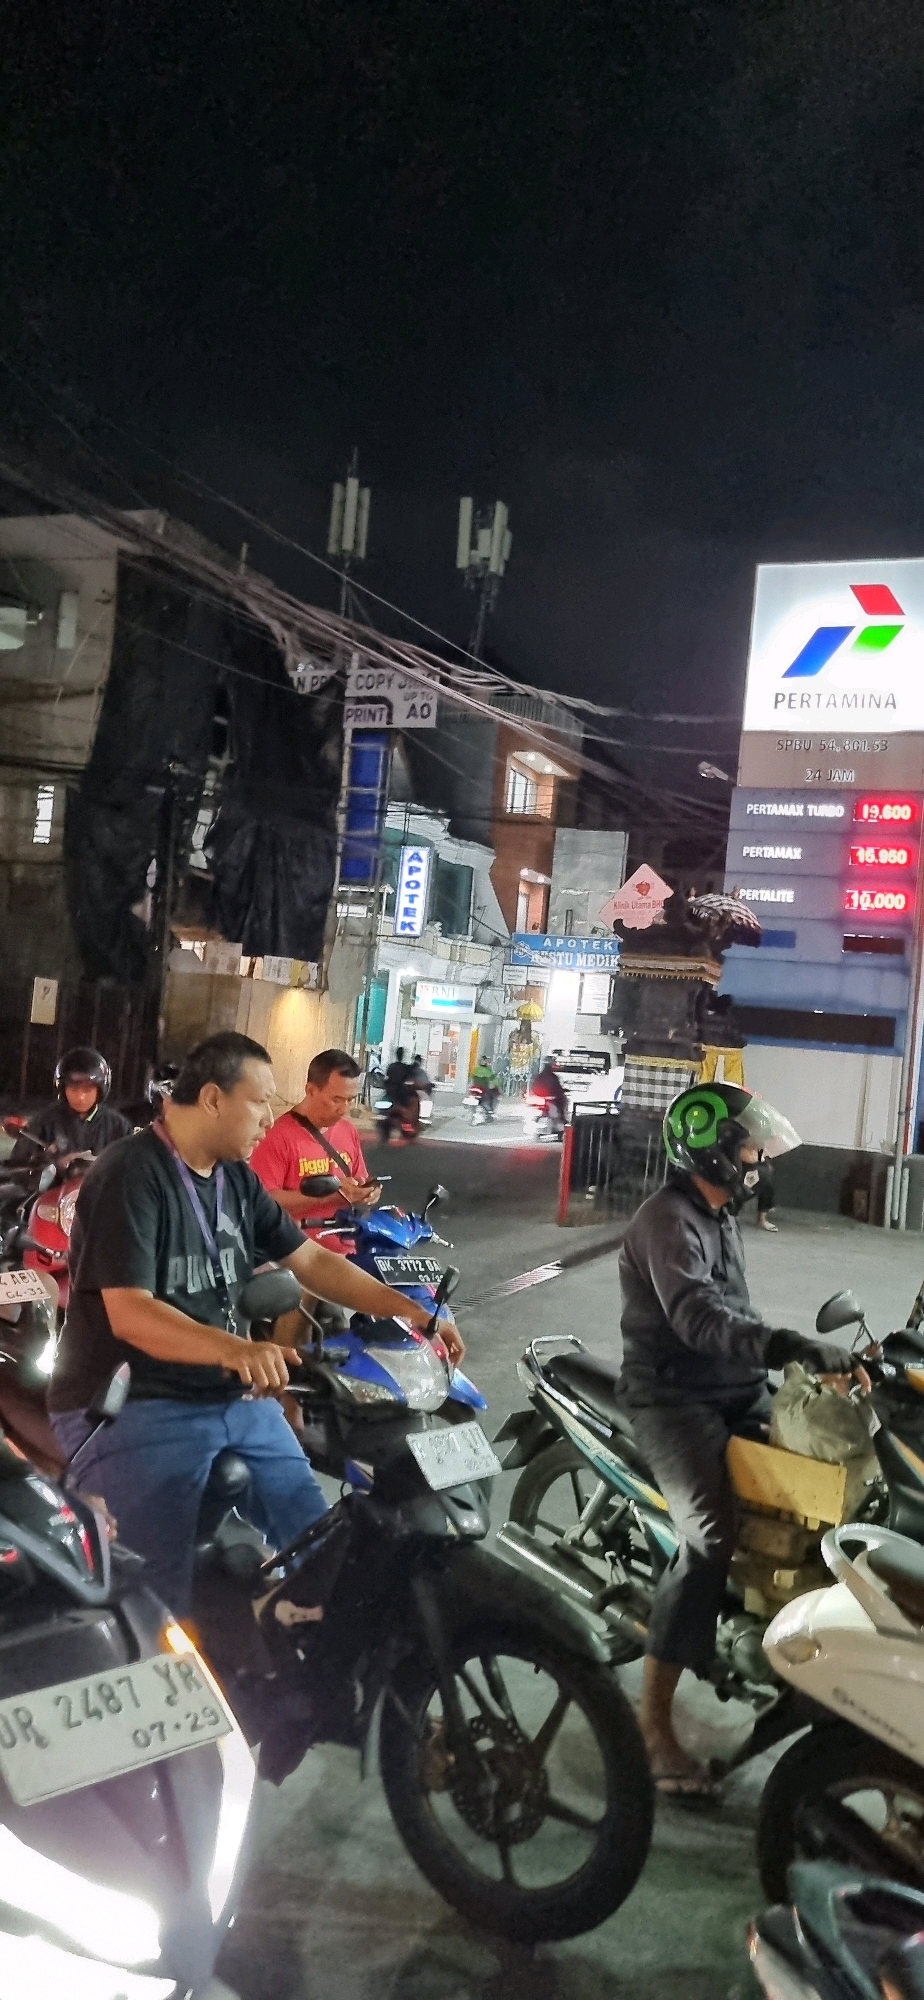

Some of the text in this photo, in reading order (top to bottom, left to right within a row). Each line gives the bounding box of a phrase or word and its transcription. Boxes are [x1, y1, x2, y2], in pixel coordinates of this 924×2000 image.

[355, 673, 396, 690] COPY
[773, 692, 897, 710] PERTAMINA
[345, 706, 387, 723] PRINT
[777, 739, 813, 751] SPBU
[805, 769, 855, 783] 24 JAM
[746, 803, 844, 818] PERTAMAX TURBO
[861, 804, 912, 820] 19.600
[742, 846, 802, 860] PERTAMAX
[400, 850, 424, 933] APOTEK
[738, 888, 795, 903] PERTALITE
[631, 901, 651, 909] Utama
[851, 892, 906, 910] 10.000
[543, 937, 614, 951] APOTEK
[377, 1260, 394, 1272] DK
[398, 1260, 425, 1272] 3772
[53, 1675, 141, 1729] 2487
[153, 1660, 202, 1707] YR
